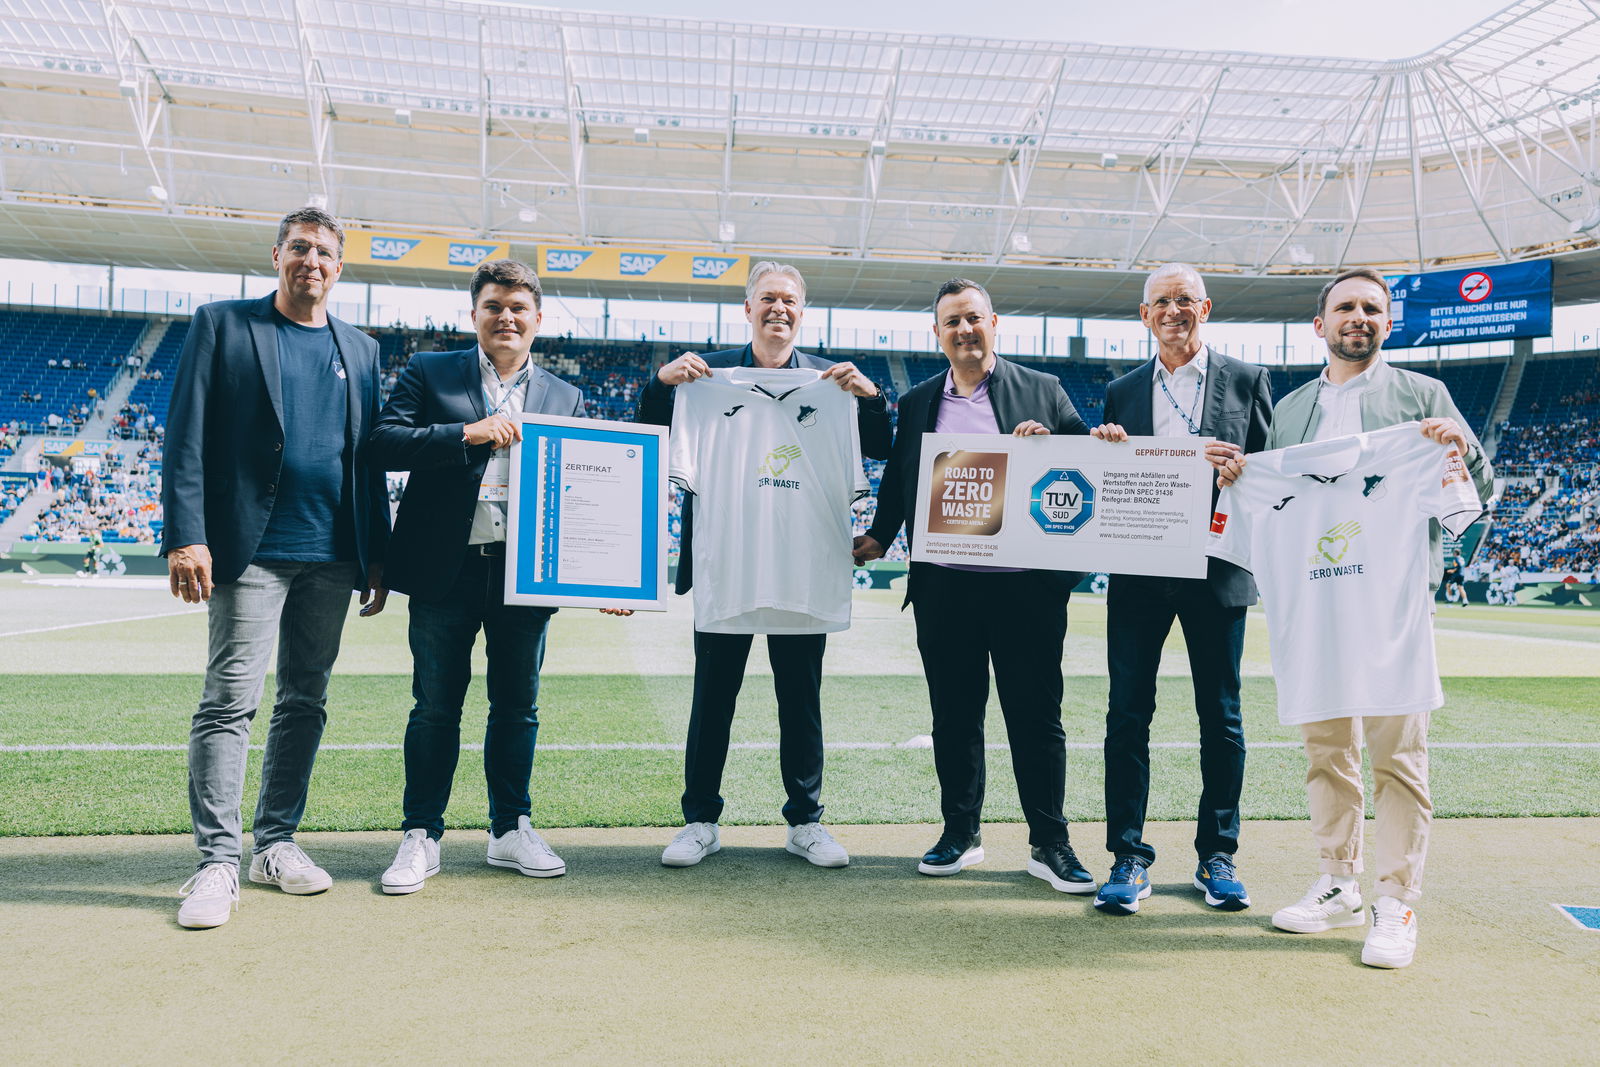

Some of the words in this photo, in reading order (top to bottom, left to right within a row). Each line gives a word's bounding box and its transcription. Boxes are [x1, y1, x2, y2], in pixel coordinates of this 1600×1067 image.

[371, 239, 410, 258] SAP
[449, 246, 487, 264] SAP
[546, 252, 584, 269] SAP
[620, 256, 657, 273] SAP
[693, 259, 729, 276] SAP
[1430, 307, 1453, 317] BITTE
[1455, 303, 1492, 314] RAUCHEN
[1494, 301, 1508, 310] SIE
[1510, 299, 1528, 309] NUR
[1430, 319, 1440, 327] IN
[1442, 317, 1457, 327] DEN
[1458, 311, 1527, 326] AUSGEWIESENEN
[1430, 328, 1465, 339] FLÄCHEN
[1466, 327, 1478, 336] IM
[1479, 323, 1515, 335] UMLAUF!
[879, 335, 888, 344] M
[45, 441, 68, 453] SAP
[1135, 447, 1169, 457] GEPRÜFT
[1170, 449, 1196, 457] DURCH
[565, 463, 612, 473] ZERTIFIKAT
[944, 467, 977, 480] ROAD
[979, 468, 994, 480] TO
[1103, 471, 1128, 479] Umgang
[773, 479, 800, 490] WASTE
[942, 480, 993, 502] ZERO
[1046, 492, 1079, 507] TÜV
[1101, 496, 1132, 504] Reifegrad:
[941, 502, 992, 519] WASTE
[925, 549, 994, 557] www.road-to-zero-waste.com
[1309, 567, 1332, 580] ZERO
[1333, 564, 1364, 576] WASTE
